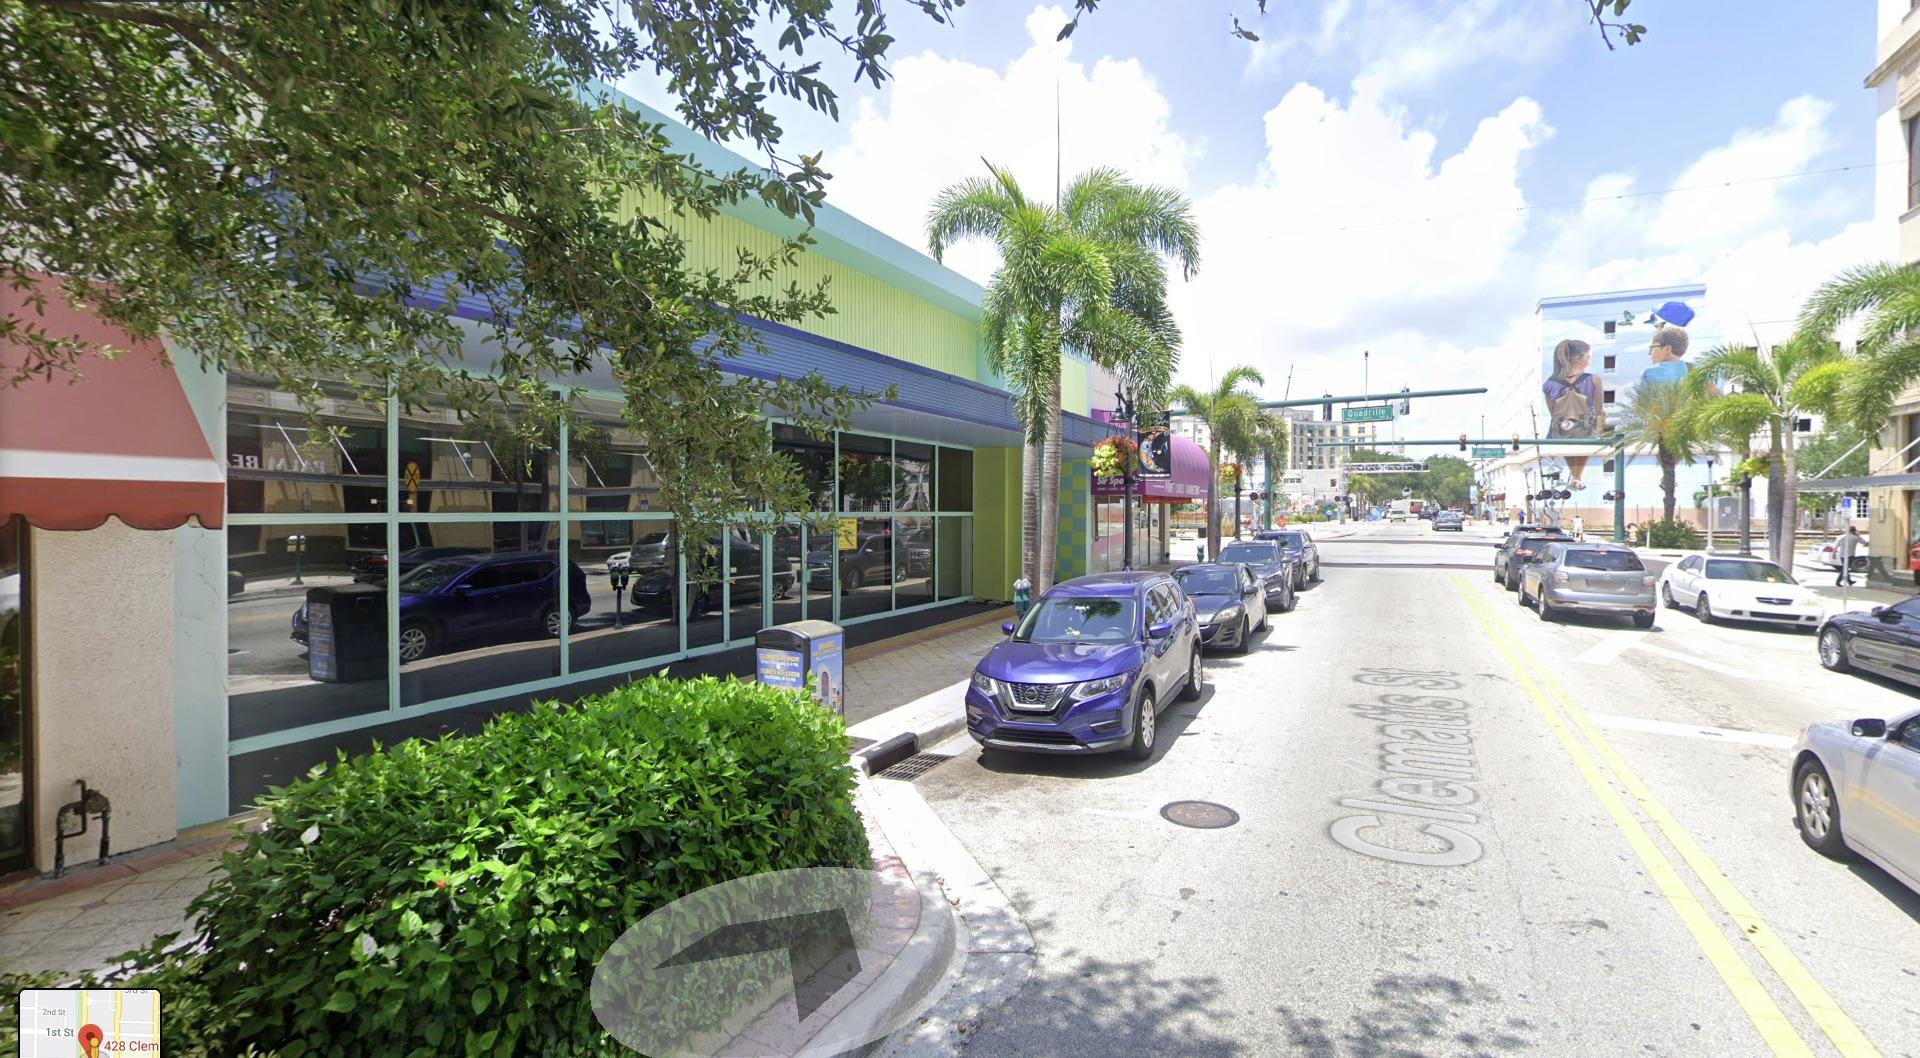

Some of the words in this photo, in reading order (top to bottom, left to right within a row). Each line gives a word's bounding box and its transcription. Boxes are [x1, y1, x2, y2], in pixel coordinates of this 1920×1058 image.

[1347, 408, 1386, 418] Quadrille
[1353, 668, 1464, 690] St
[1327, 694, 1484, 867] Clematis
